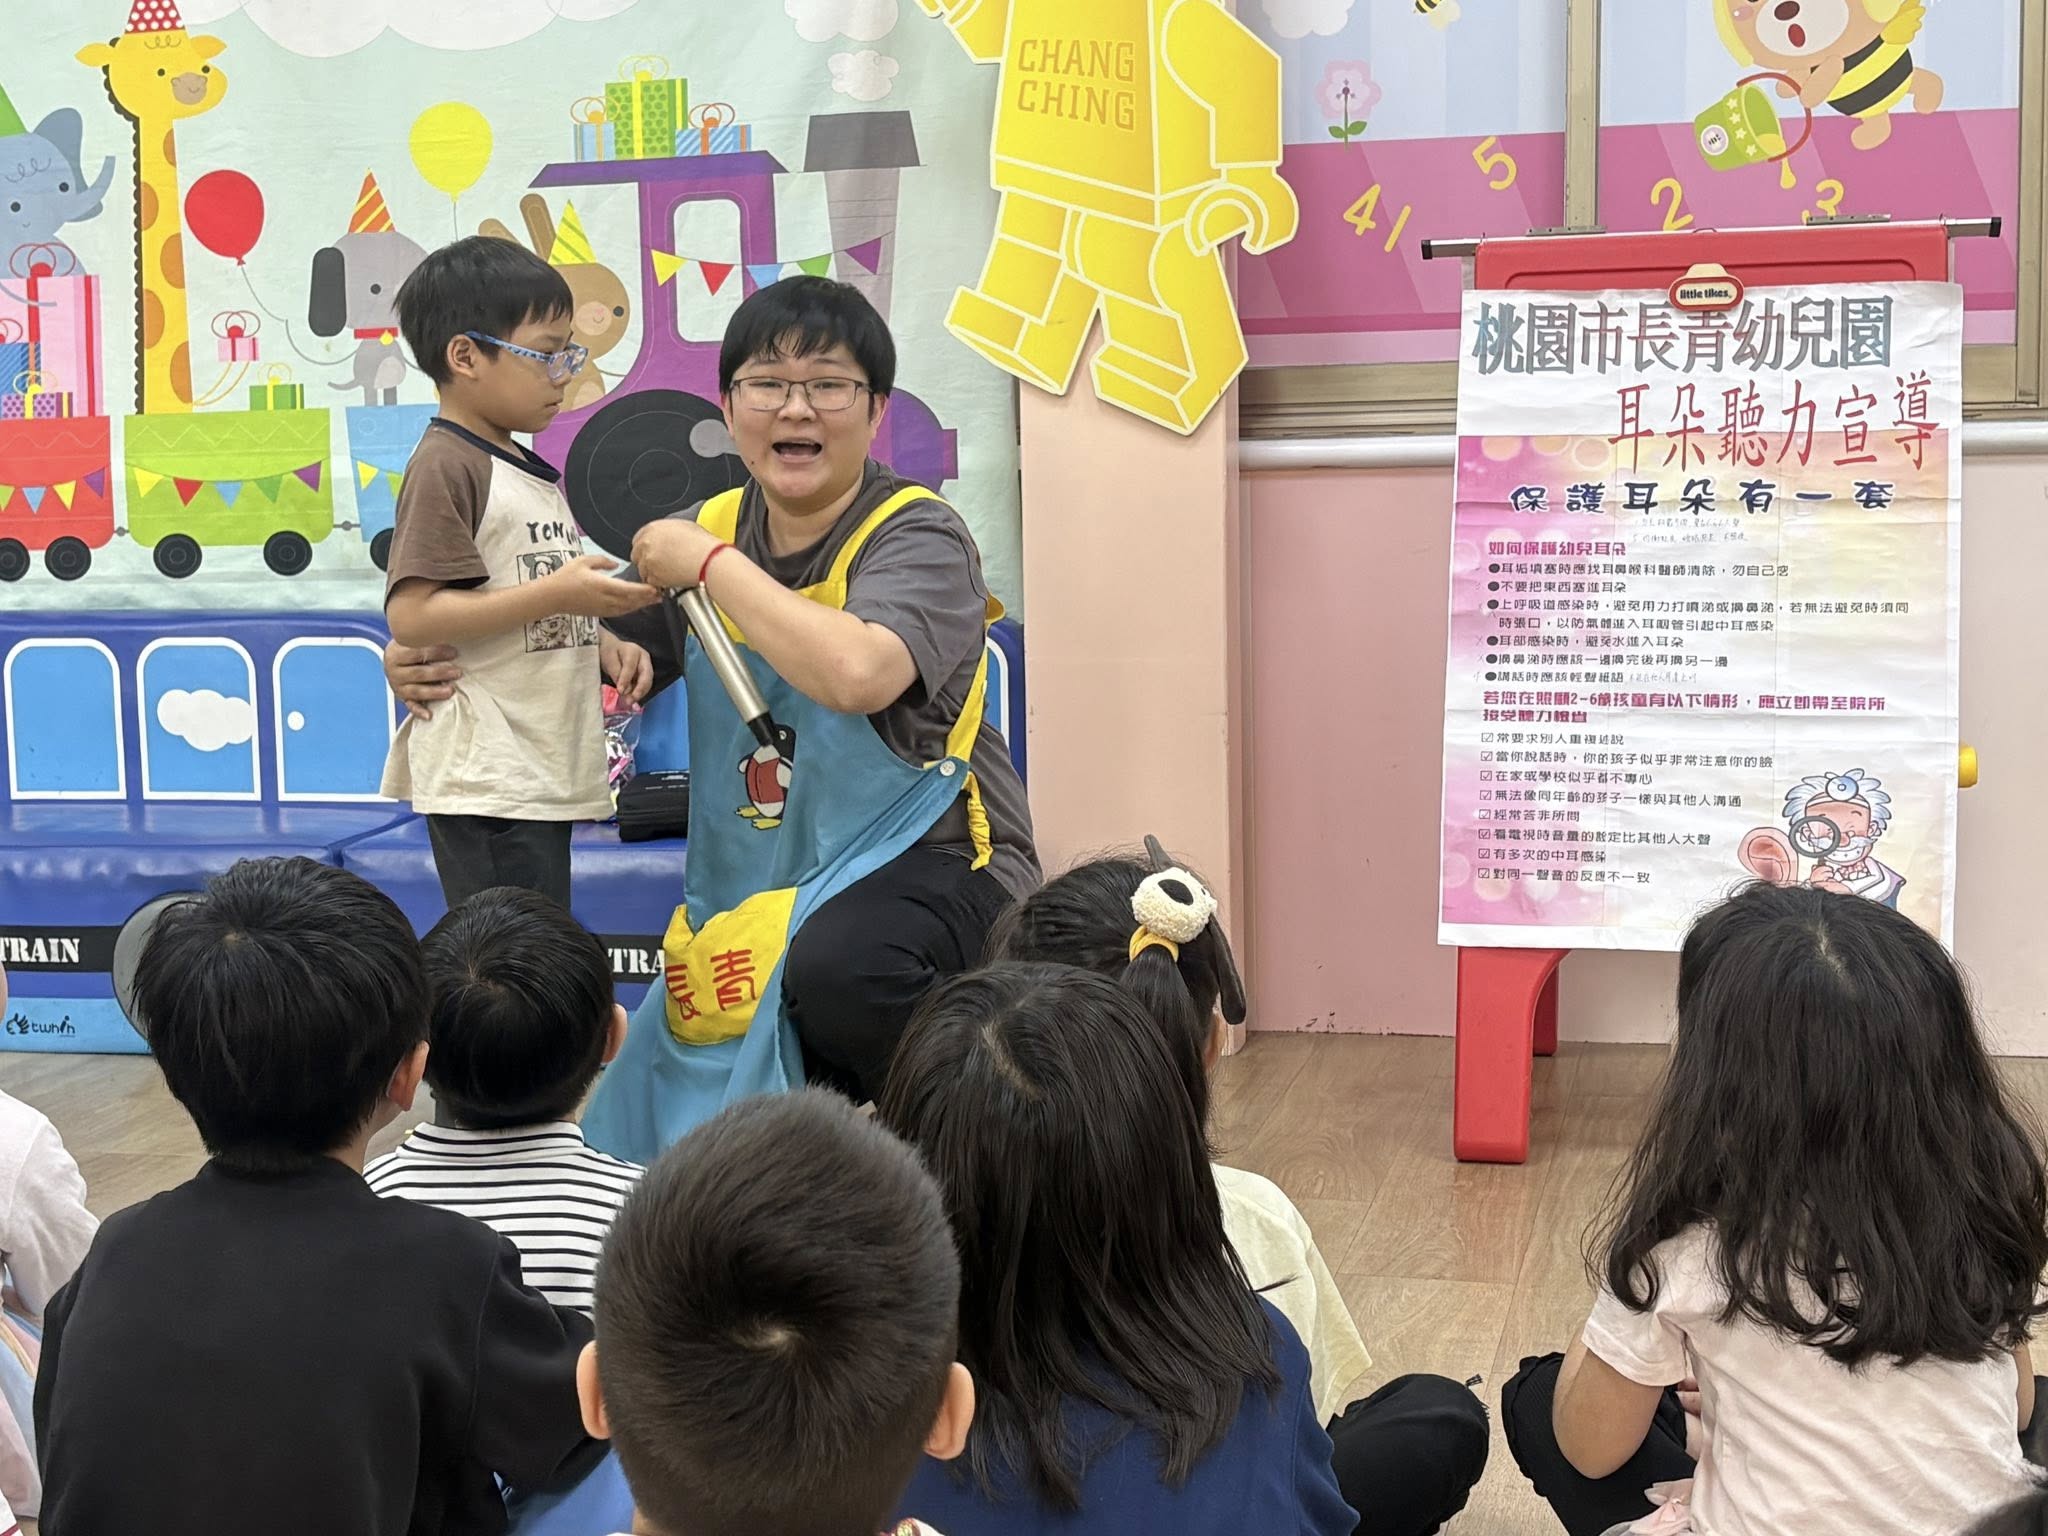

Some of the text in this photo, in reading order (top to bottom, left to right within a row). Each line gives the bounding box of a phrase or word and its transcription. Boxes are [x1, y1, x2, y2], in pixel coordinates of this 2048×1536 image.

[1018, 39, 1135, 82] CHANG
[1018, 80, 1135, 131] CHING
[1472, 135, 1518, 190] 5
[1343, 183, 1382, 236] 4
[1650, 177, 1694, 231] 2
[1680, 289, 1703, 299] little
[1471, 294, 1894, 376] 桃園市長青幼兒園
[1608, 370, 1941, 475] 耳朵聽力宣導
[1510, 478, 1897, 515] 保護耳朵有一套
[1488, 541, 1627, 556] 如何保護幼兒耳朵
[1500, 581, 1627, 593] 不要把東西塞進耳朵
[1482, 708, 1588, 723] 接受聽力檢查
[1493, 809, 1581, 822] 經常答非所問
[1493, 848, 1607, 863] 有多次的中耳感染
[0, 937, 80, 963] TRAIN
